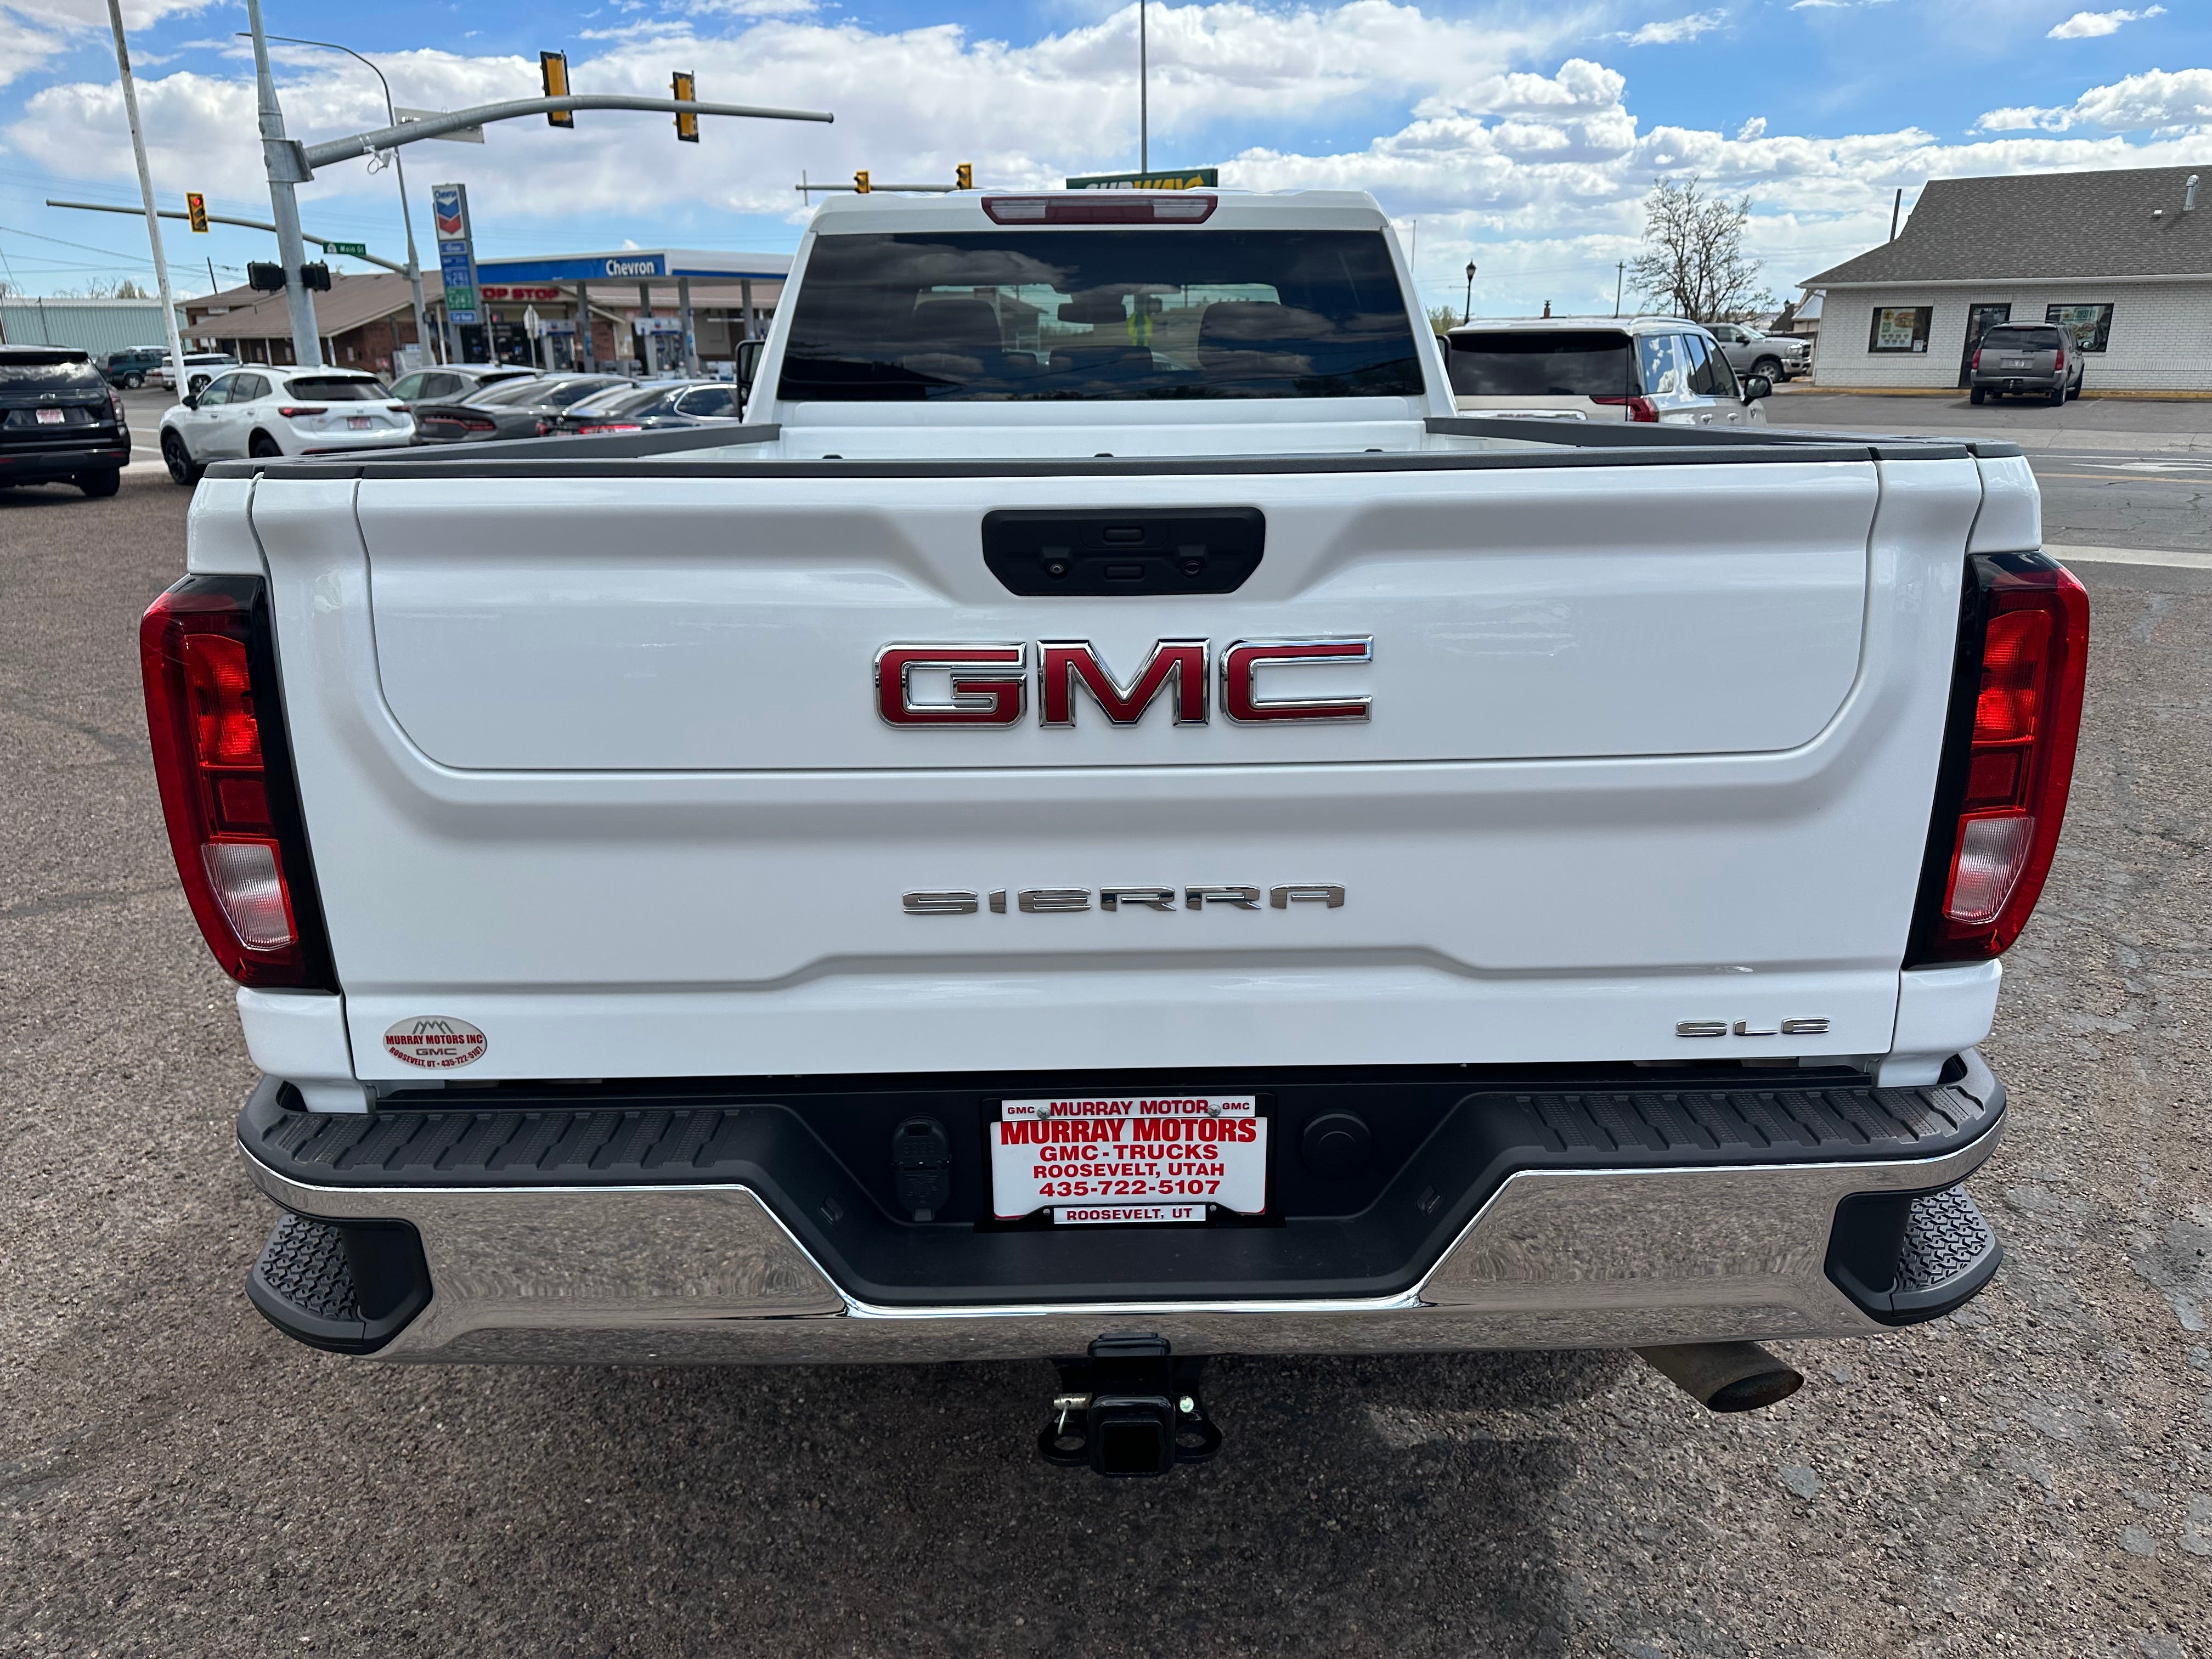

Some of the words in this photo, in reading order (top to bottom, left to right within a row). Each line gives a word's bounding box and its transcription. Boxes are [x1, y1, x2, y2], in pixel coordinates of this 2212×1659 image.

[605, 259, 655, 276] Chevron
[482, 287, 508, 299] OP
[874, 635, 1373, 729] GMC
[902, 882, 1346, 915] SIERRA
[1677, 1017, 1831, 1037] SLE
[386, 1035, 424, 1045] MURRAY
[426, 1035, 465, 1045] MOTORS
[466, 1034, 483, 1044] INC
[389, 1047, 426, 1067] ROOSEVELT,
[441, 1046, 483, 1067] 435-722-5107
[1007, 1106, 1035, 1114] GMC
[1050, 1101, 1133, 1116] MURRAY
[1140, 1099, 1209, 1115] MOTOR
[1001, 1119, 1126, 1145] MURRAY
[1133, 1118, 1256, 1143] MOTORS
[1034, 1163, 1161, 1178] ROOSEVELT,
[1168, 1163, 1224, 1176] UTAH
[1039, 1180, 1221, 1197] 435-722-5107
[1067, 1209, 1165, 1221] ROOSEVELT,
[1172, 1208, 1193, 1218] UT
